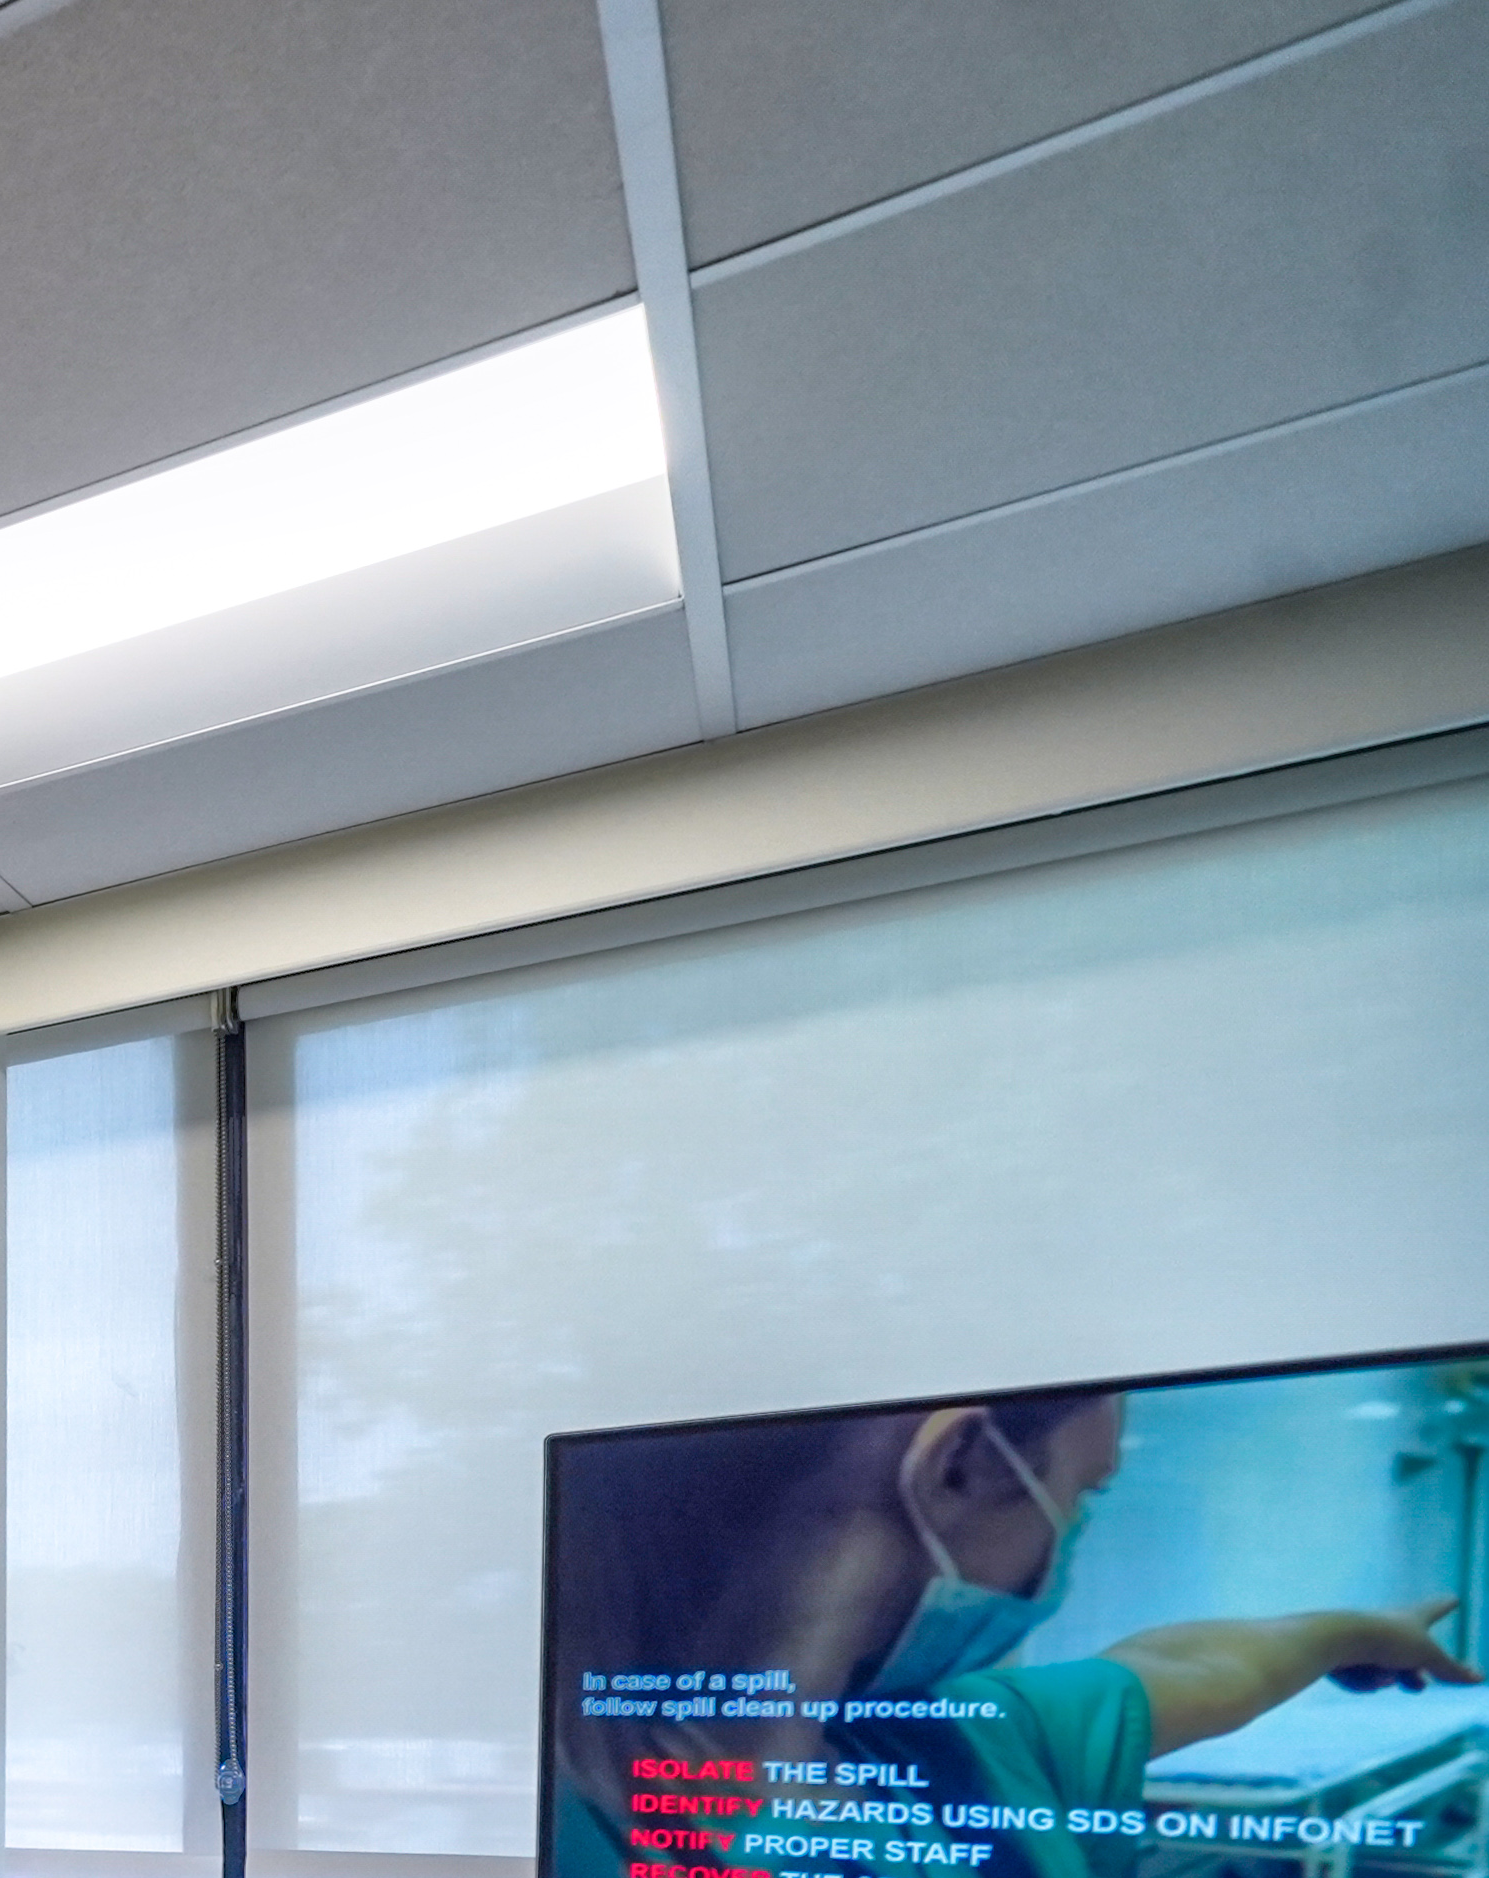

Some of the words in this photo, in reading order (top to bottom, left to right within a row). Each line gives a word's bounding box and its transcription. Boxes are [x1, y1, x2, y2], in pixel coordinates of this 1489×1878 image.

[581, 1671, 605, 1691] In
[610, 1675, 671, 1691] case
[675, 1671, 706, 1691] of
[708, 1674, 727, 1691] a
[730, 1669, 797, 1696] spill,
[581, 1696, 657, 1718] follow
[661, 1696, 716, 1722] spill
[720, 1696, 794, 1718] clean
[800, 1701, 838, 1722] up
[844, 1697, 1007, 1723] procedure.
[632, 1758, 754, 1783] ISOLATE
[762, 1761, 828, 1785] THE
[834, 1762, 930, 1788] SPILL
[631, 1793, 764, 1817] IDENTIFY
[771, 1798, 934, 1827] HAZARDS
[941, 1803, 1055, 1832] USING
[1066, 1808, 1146, 1836] SDS
[1155, 1811, 1218, 1839] ON
[1229, 1814, 1425, 1847] INFONET
[631, 1828, 736, 1851] NOTIFY
[744, 1833, 875, 1861] PROPER
[884, 1840, 993, 1867] STAFF
